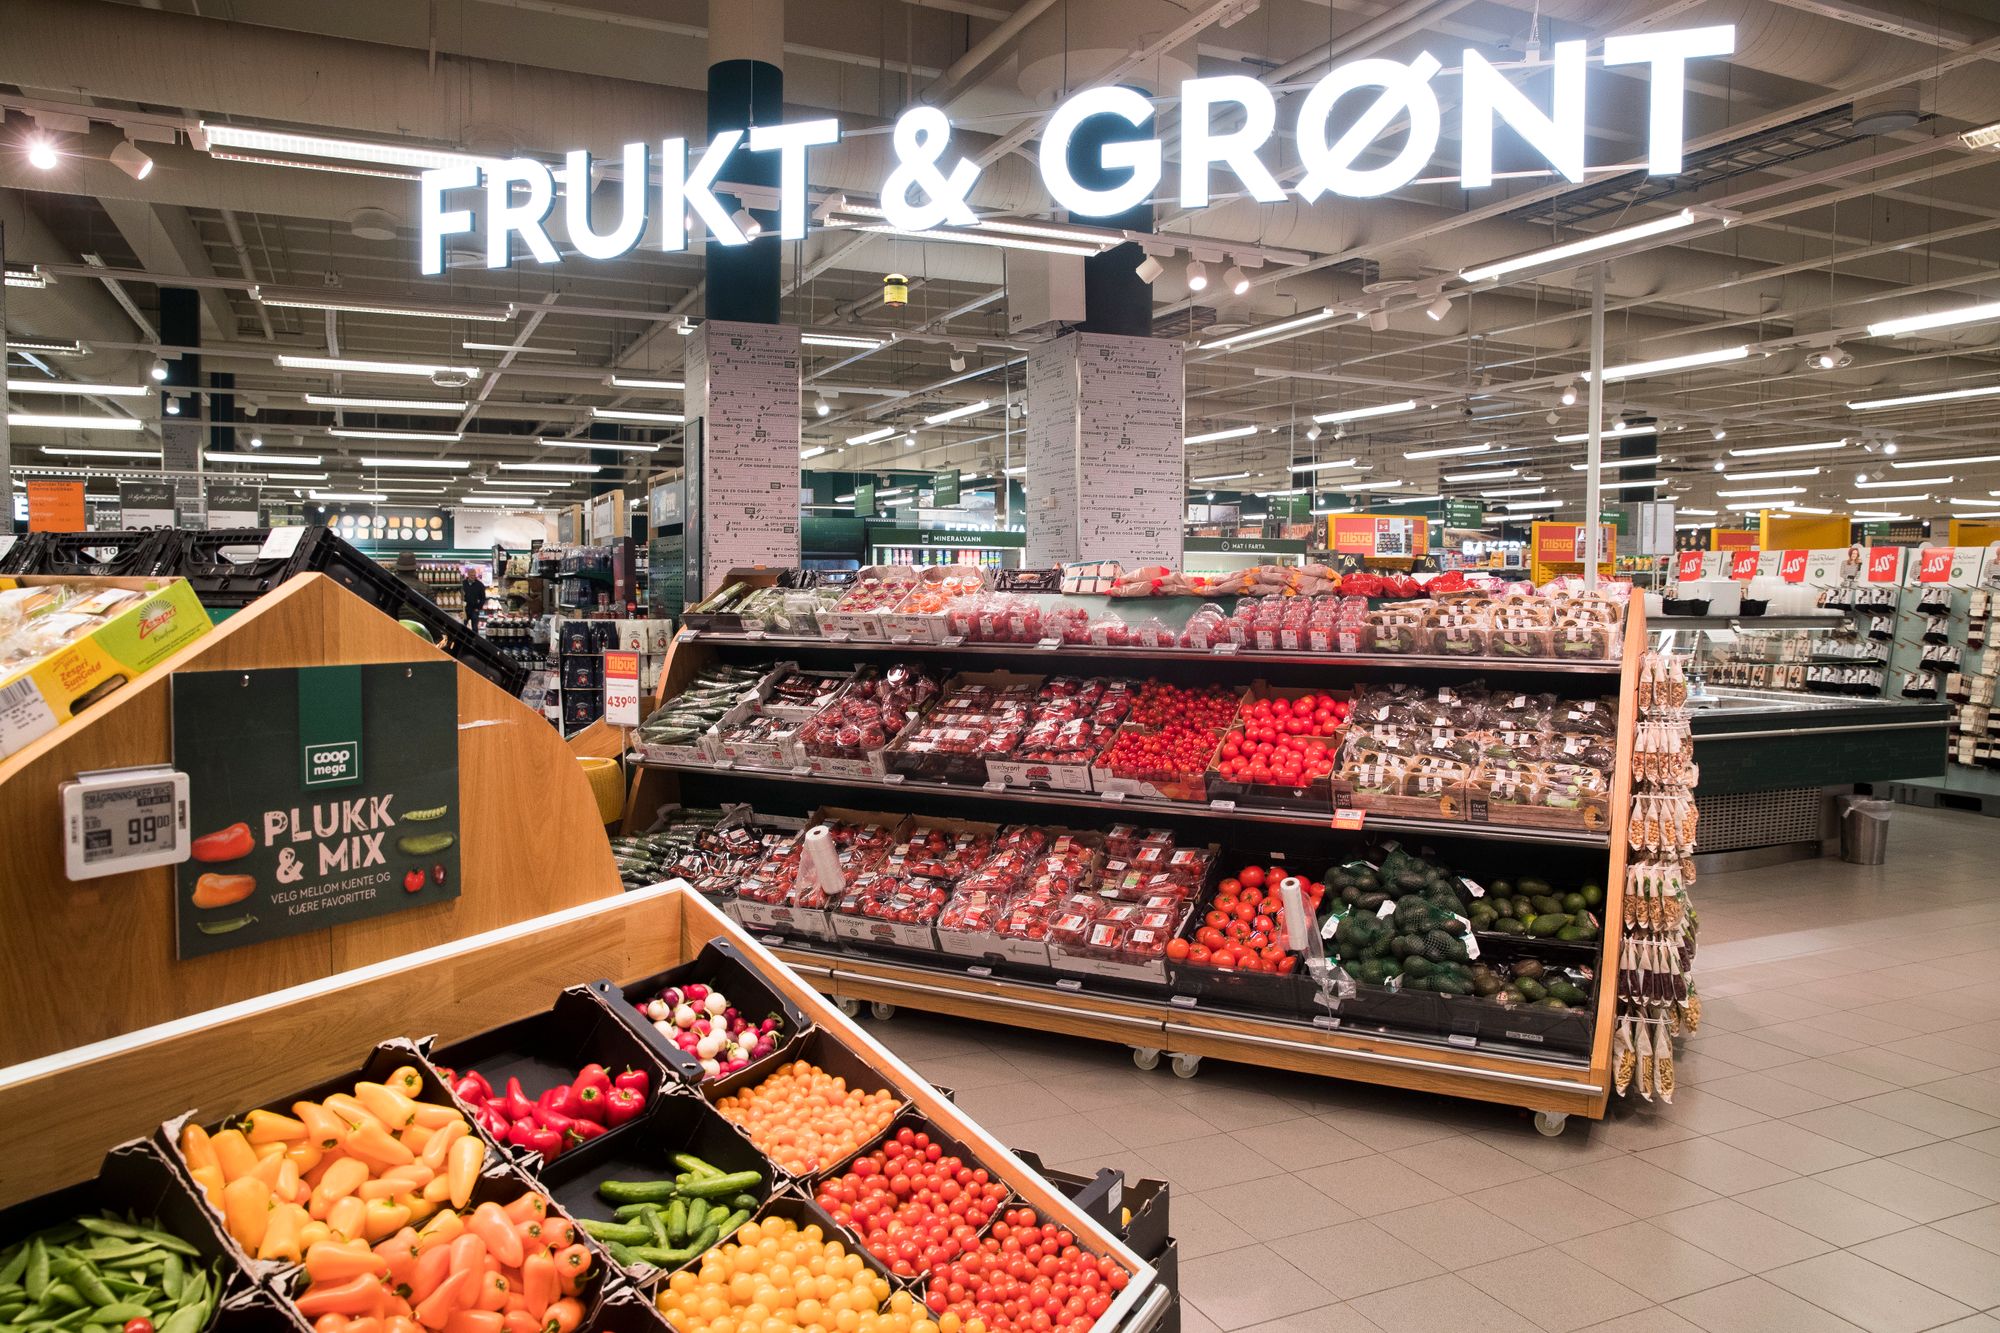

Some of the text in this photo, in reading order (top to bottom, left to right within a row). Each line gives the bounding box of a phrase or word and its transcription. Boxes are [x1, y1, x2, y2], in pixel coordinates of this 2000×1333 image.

[421, 23, 1736, 276] FRUKT & GRØNT
[933, 535, 981, 543] MINERALVANN
[1338, 532, 1373, 544] Tilbud
[1540, 538, 1574, 550] Tilbud
[1681, 556, 1700, 574] -40%
[1734, 556, 1756, 574] -40%
[1782, 555, 1805, 574] -40%
[1870, 553, 1896, 573] -40%
[1922, 552, 1951, 574] -40%
[608, 656, 637, 670] Tilbud
[313, 750, 350, 764] coop
[313, 764, 347, 776] mega
[263, 793, 396, 847] PLUKK
[276, 831, 387, 884] & MIX
[271, 871, 391, 904] VELG MELLOM KJENTE OG
[288, 888, 377, 916] KJÆRE FAVORITTER
